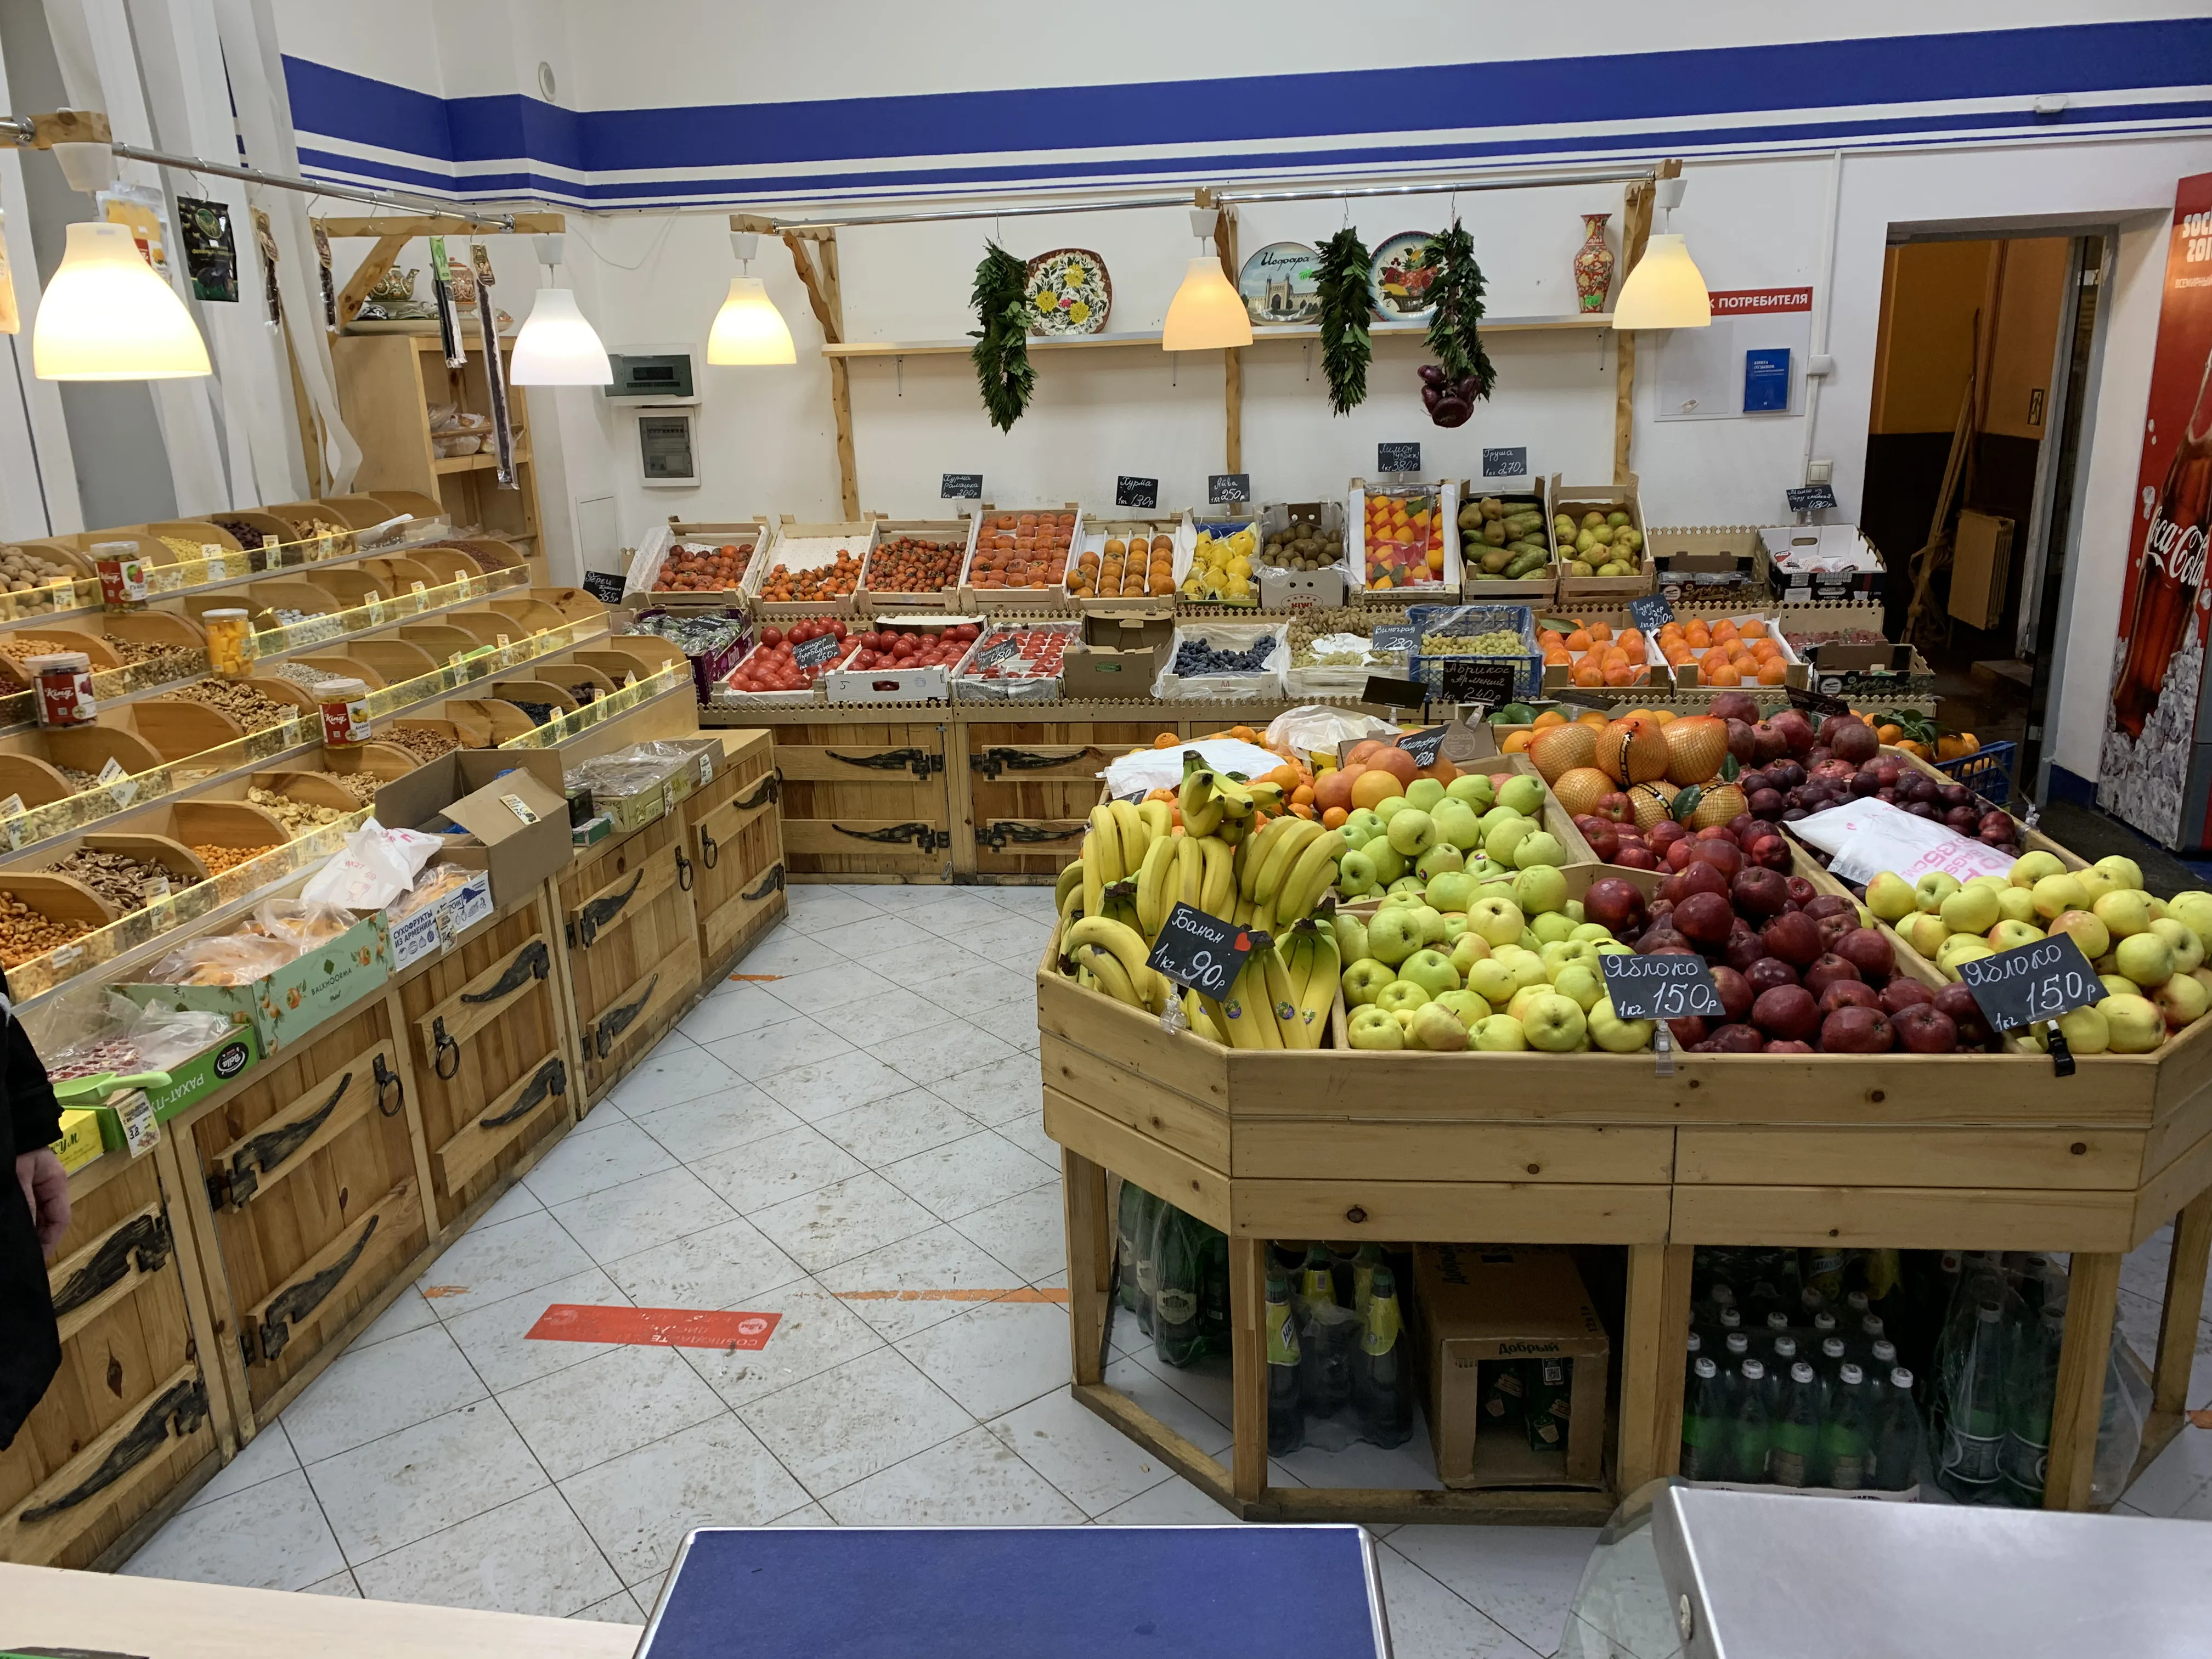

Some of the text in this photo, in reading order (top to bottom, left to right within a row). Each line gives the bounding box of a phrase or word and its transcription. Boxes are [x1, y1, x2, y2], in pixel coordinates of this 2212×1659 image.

[1719, 294, 1808, 308] ПОТРЕБИТЕЛЯ
[1483, 449, 1513, 461] Груша
[1498, 461, 1524, 475] 270р
[1120, 476, 1153, 490] Хурма
[1215, 476, 1239, 489] Айва
[1375, 625, 1415, 634] Виноград
[1443, 663, 1510, 679] Абрикос
[44, 687, 75, 701] King
[324, 713, 347, 725] King
[393, 909, 433, 939] СУХОФРУКТЫ
[1171, 908, 1224, 944] Банан
[394, 937, 403, 948] ИЗ
[404, 919, 432, 943] АРМЕНИИ
[1605, 955, 1698, 978] Яблоко
[1965, 945, 2062, 986] Яблоко
[311, 968, 352, 996] BALKHOORMA
[1653, 981, 1717, 1014] 150р
[2026, 971, 2096, 1017] 150р
[222, 1052, 241, 1068] Bella
[650, 1334, 758, 1347] СОБЛЮДАТЕ
[1499, 1342, 1560, 1355] Добрый
